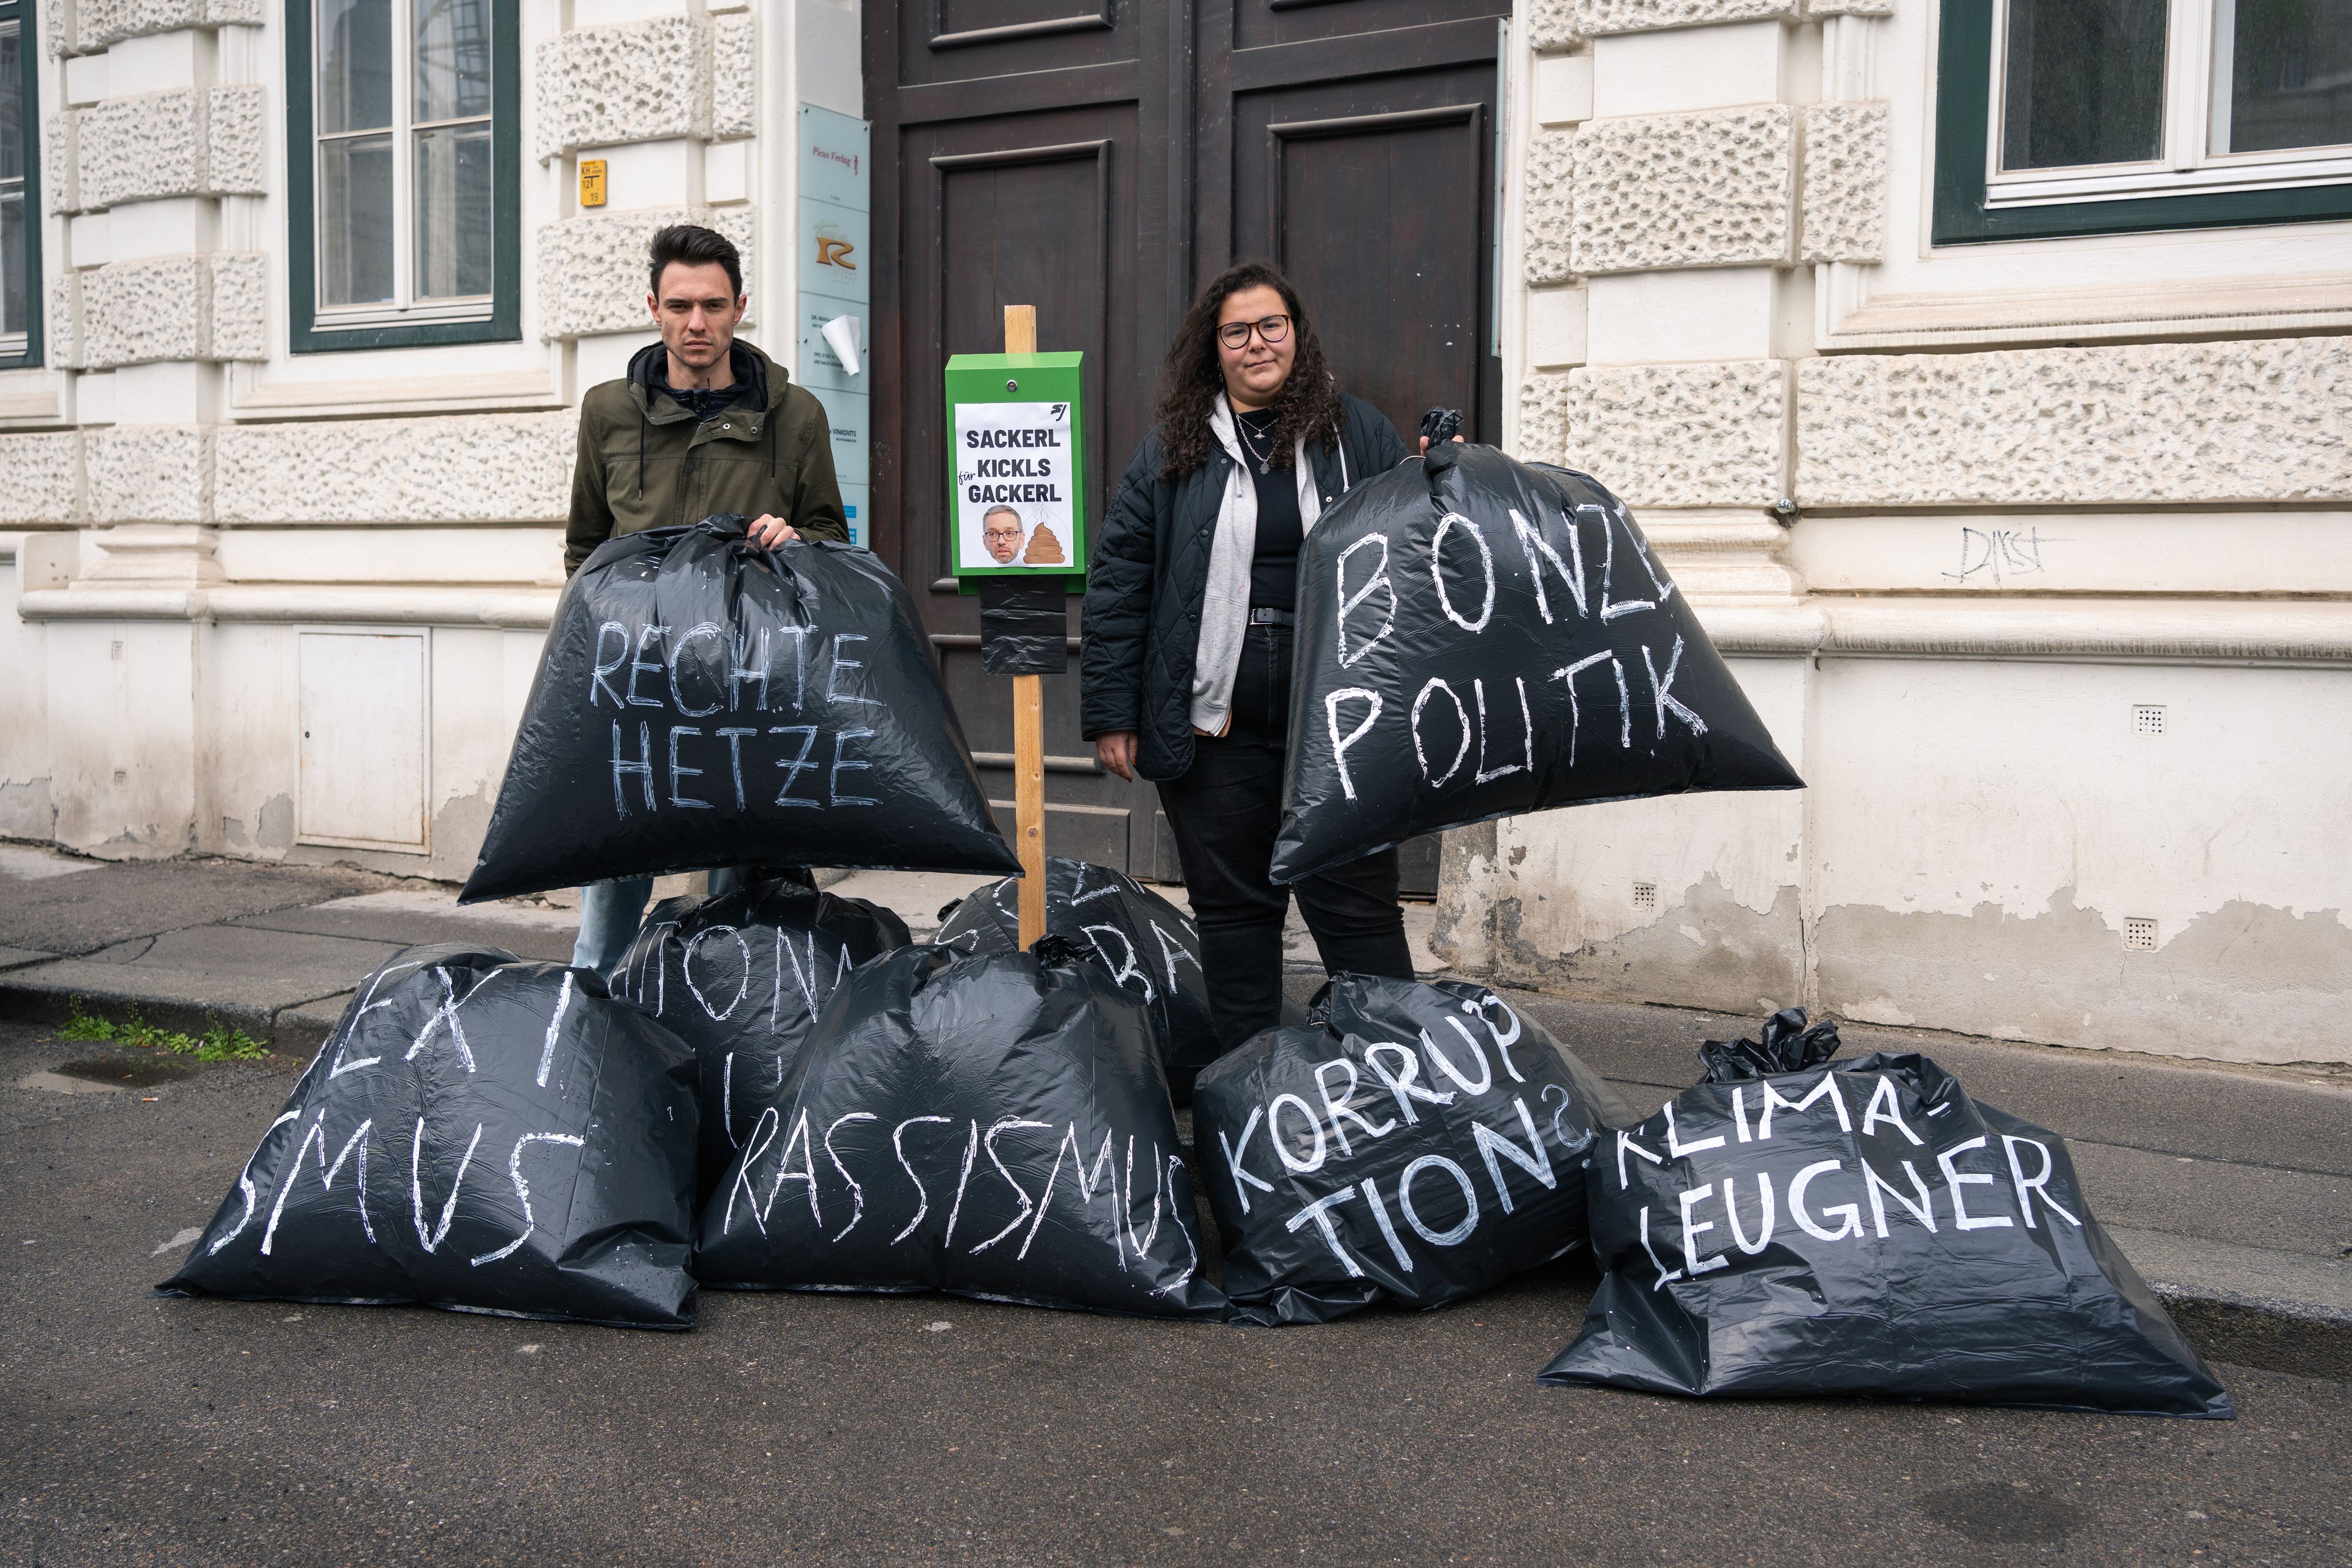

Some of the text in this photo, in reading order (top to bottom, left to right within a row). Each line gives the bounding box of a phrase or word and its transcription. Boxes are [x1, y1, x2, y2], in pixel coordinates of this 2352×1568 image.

[812, 146, 851, 168] Picus Verlag
[832, 428, 857, 437] VINKOVITS
[958, 458, 1051, 486] für KICKLS
[966, 429, 1061, 449] SACKERL
[968, 484, 1062, 503] GACKERL
[590, 621, 887, 717] RECHTE
[1324, 632, 1709, 802] POLITIK
[608, 718, 883, 820] HETZE
[1218, 995, 1526, 1216] KORRUP
[208, 1108, 586, 1268] SMUS
[723, 1106, 1198, 1297] RASSISMUS
[1639, 1134, 2083, 1292] LEUGNER
